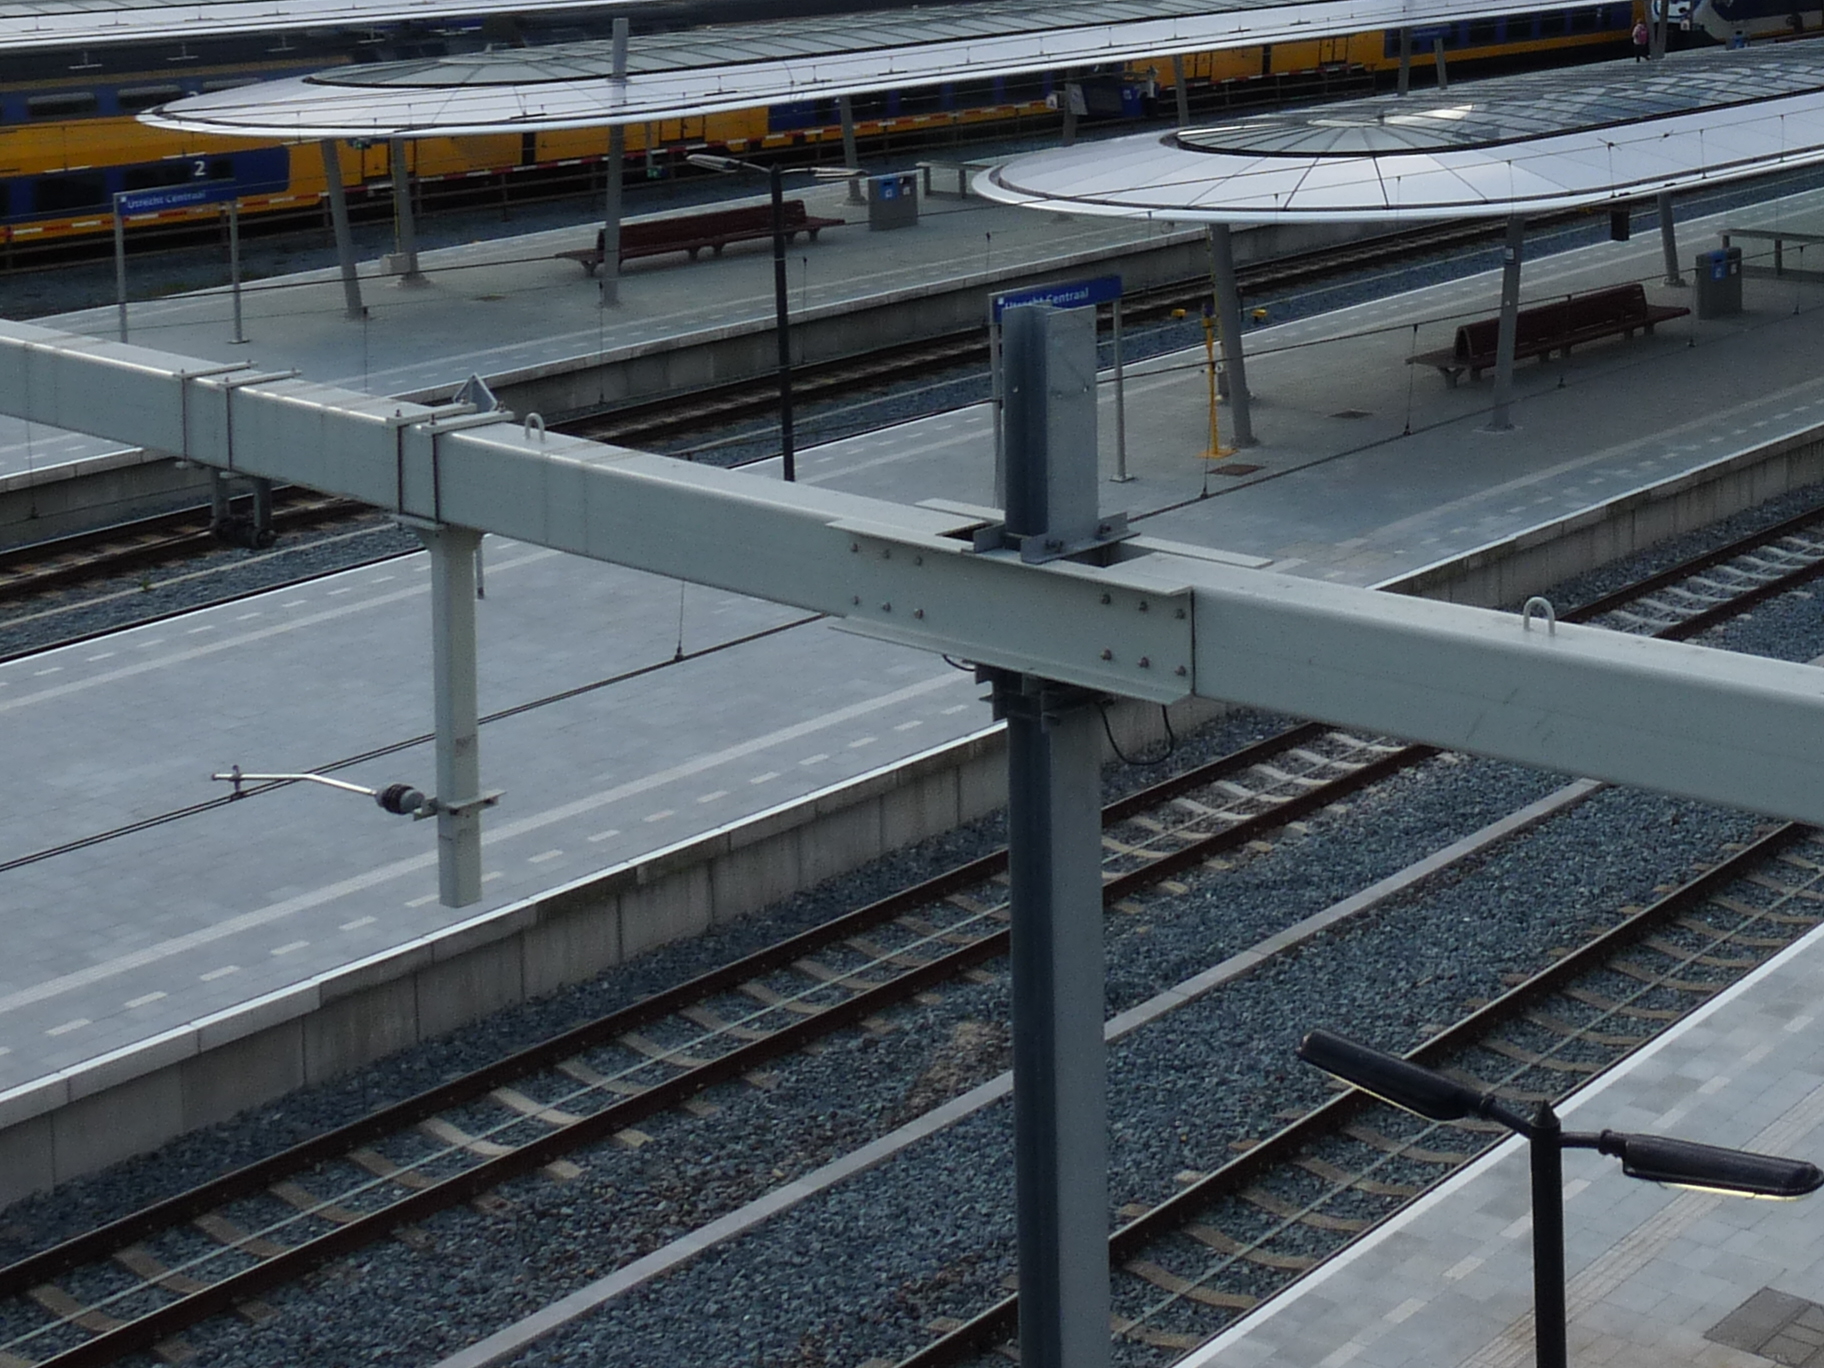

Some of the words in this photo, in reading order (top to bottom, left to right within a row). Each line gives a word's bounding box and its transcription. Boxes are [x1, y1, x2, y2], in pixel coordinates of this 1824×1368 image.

[193, 160, 207, 176] 2
[127, 195, 163, 209] Utrecht
[165, 191, 207, 204] Centraal
